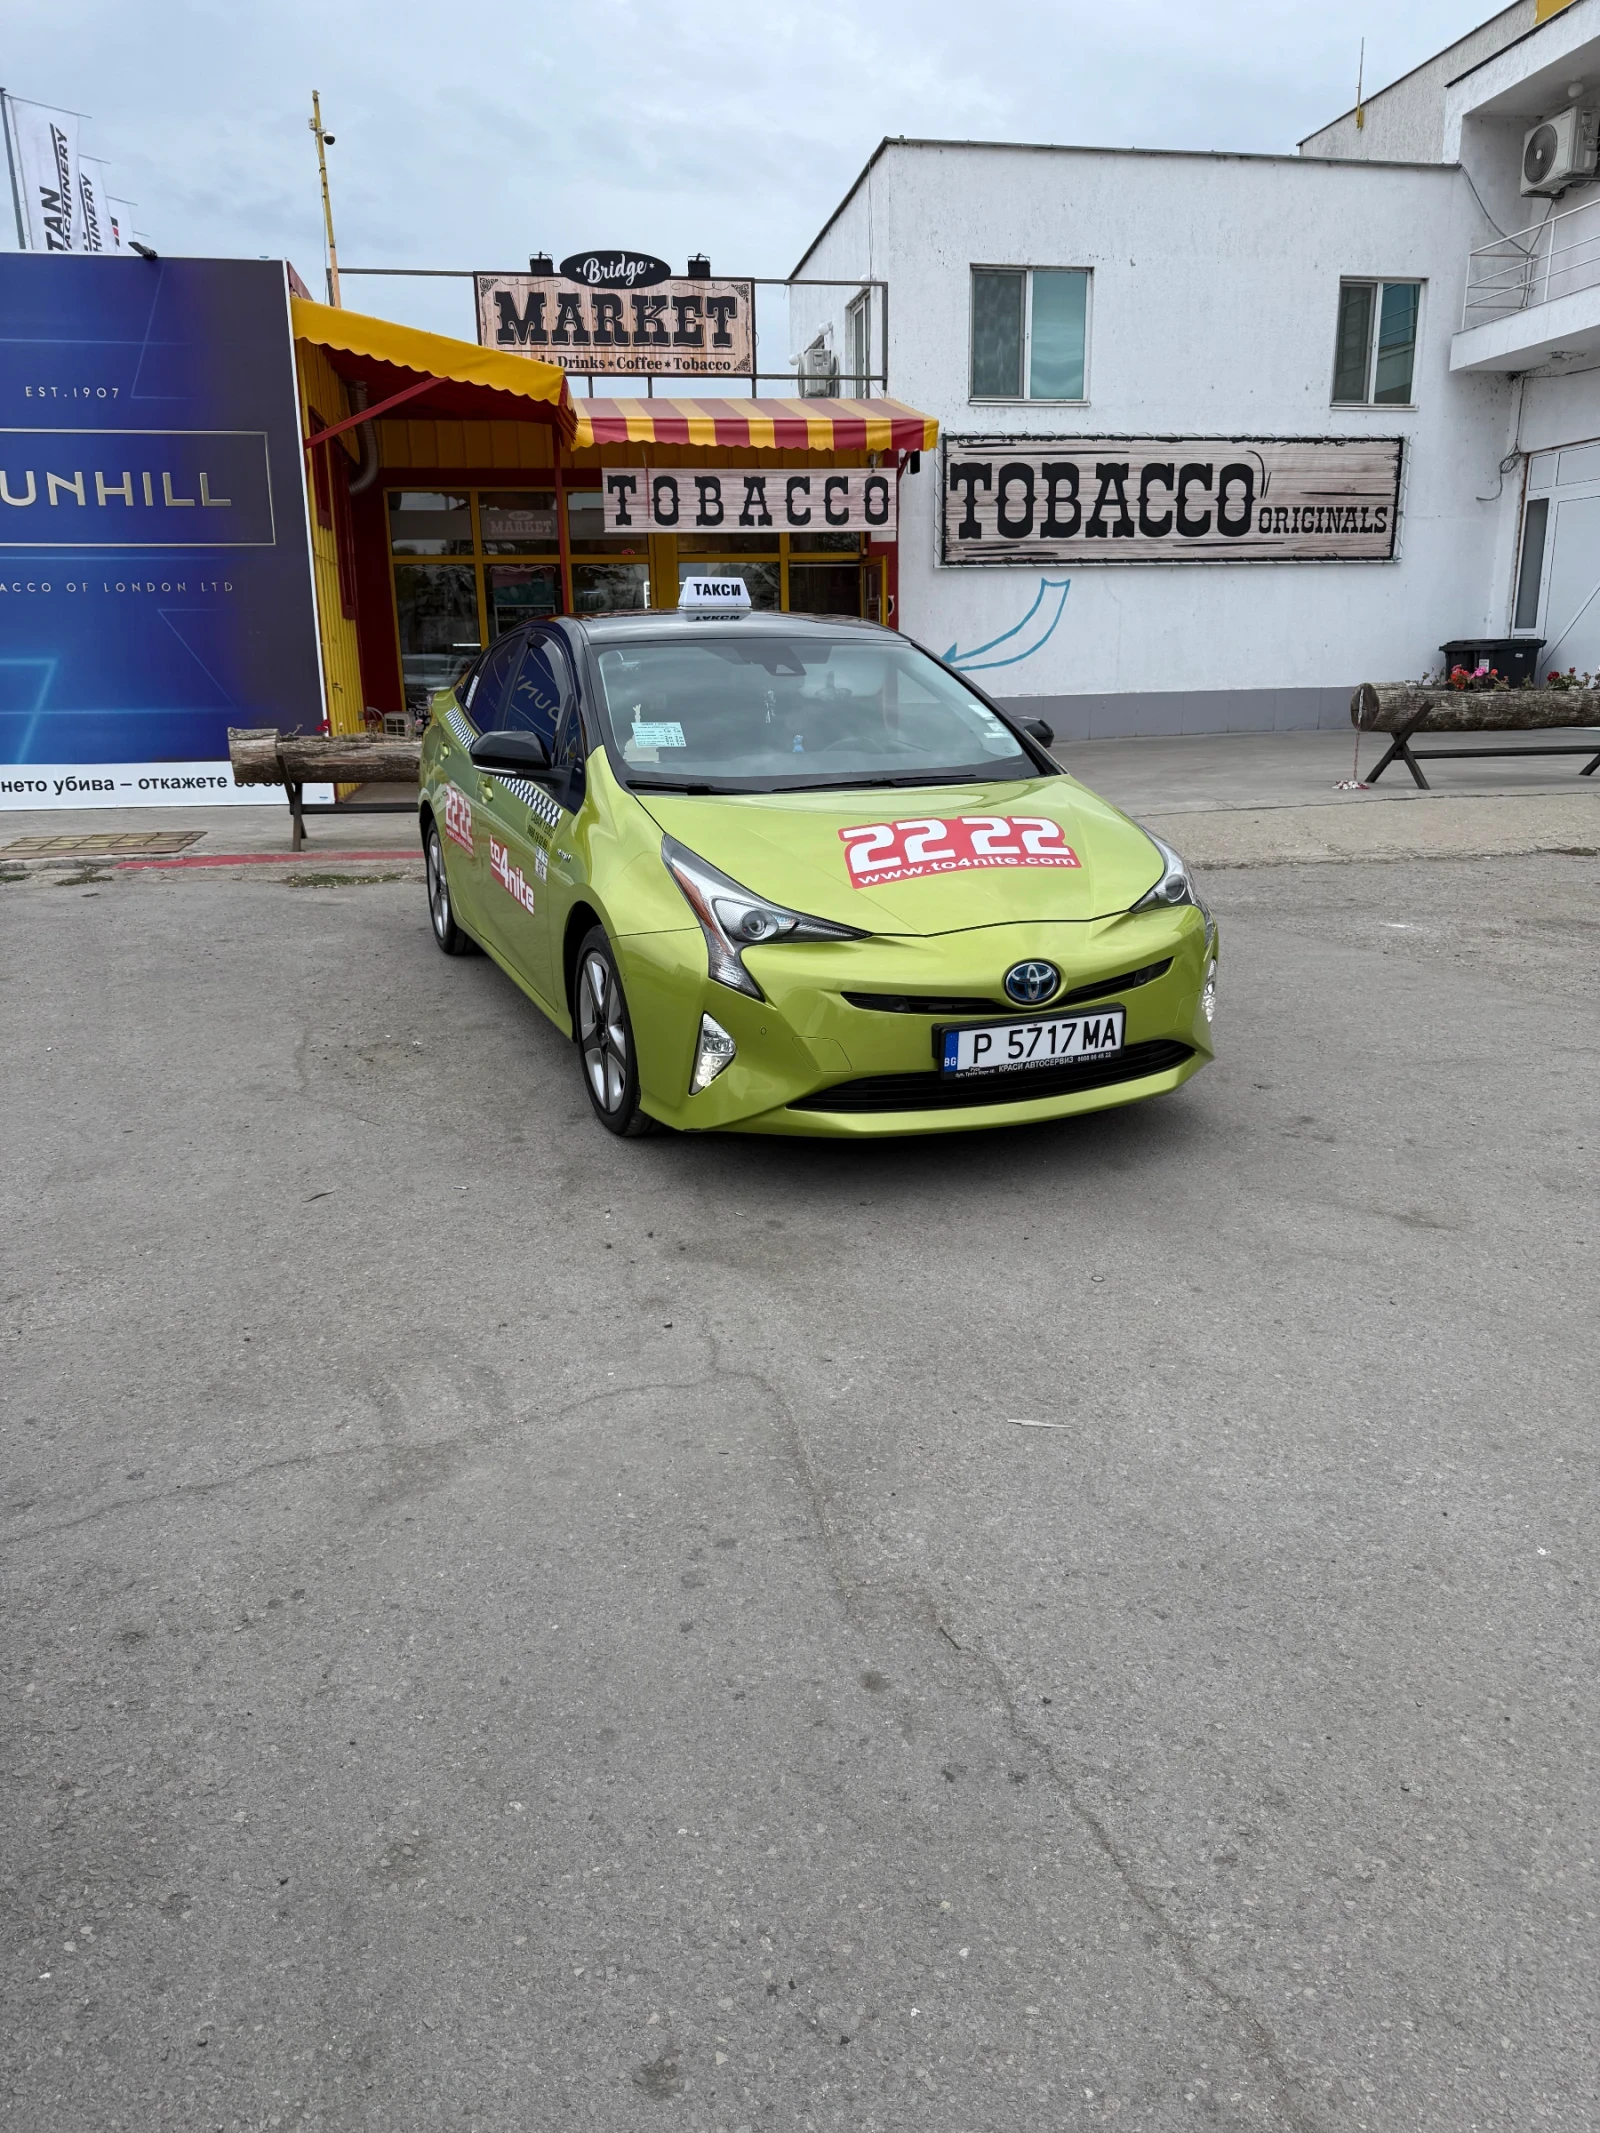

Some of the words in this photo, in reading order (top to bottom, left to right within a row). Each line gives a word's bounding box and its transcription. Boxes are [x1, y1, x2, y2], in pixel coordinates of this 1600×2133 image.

[583, 253, 648, 286] Bridge
[495, 291, 738, 348] MARKET
[557, 356, 605, 370] Drinks
[616, 356, 662, 370] Coffee
[674, 357, 731, 371] Tobacco
[25, 386, 120, 398] EST.1907
[0, 471, 232, 507] UNHILL
[607, 475, 891, 527] TOBACCO
[950, 461, 1256, 539] TOBACCO
[1258, 506, 1388, 534] ORIGINALS
[490, 520, 552, 533] MARKET
[66, 582, 89, 593] OF
[104, 582, 187, 593] LONDON
[201, 582, 233, 593] LTD
[693, 583, 741, 596] ТАКСИ
[1, 780, 48, 792] нето
[54, 775, 114, 795] убива
[138, 775, 228, 790] откажете
[489, 834, 535, 915] to4nite
[858, 855, 1076, 886] www.to4nite.com
[973, 1033, 992, 1064] P
[1008, 1022, 1077, 1060] 5717
[1082, 1017, 1117, 1051] MA
[944, 1056, 957, 1067] BG
[998, 1063, 1024, 1073] КРАСИ
[1024, 1056, 1074, 1070] АВТОСЕРВИЗ
